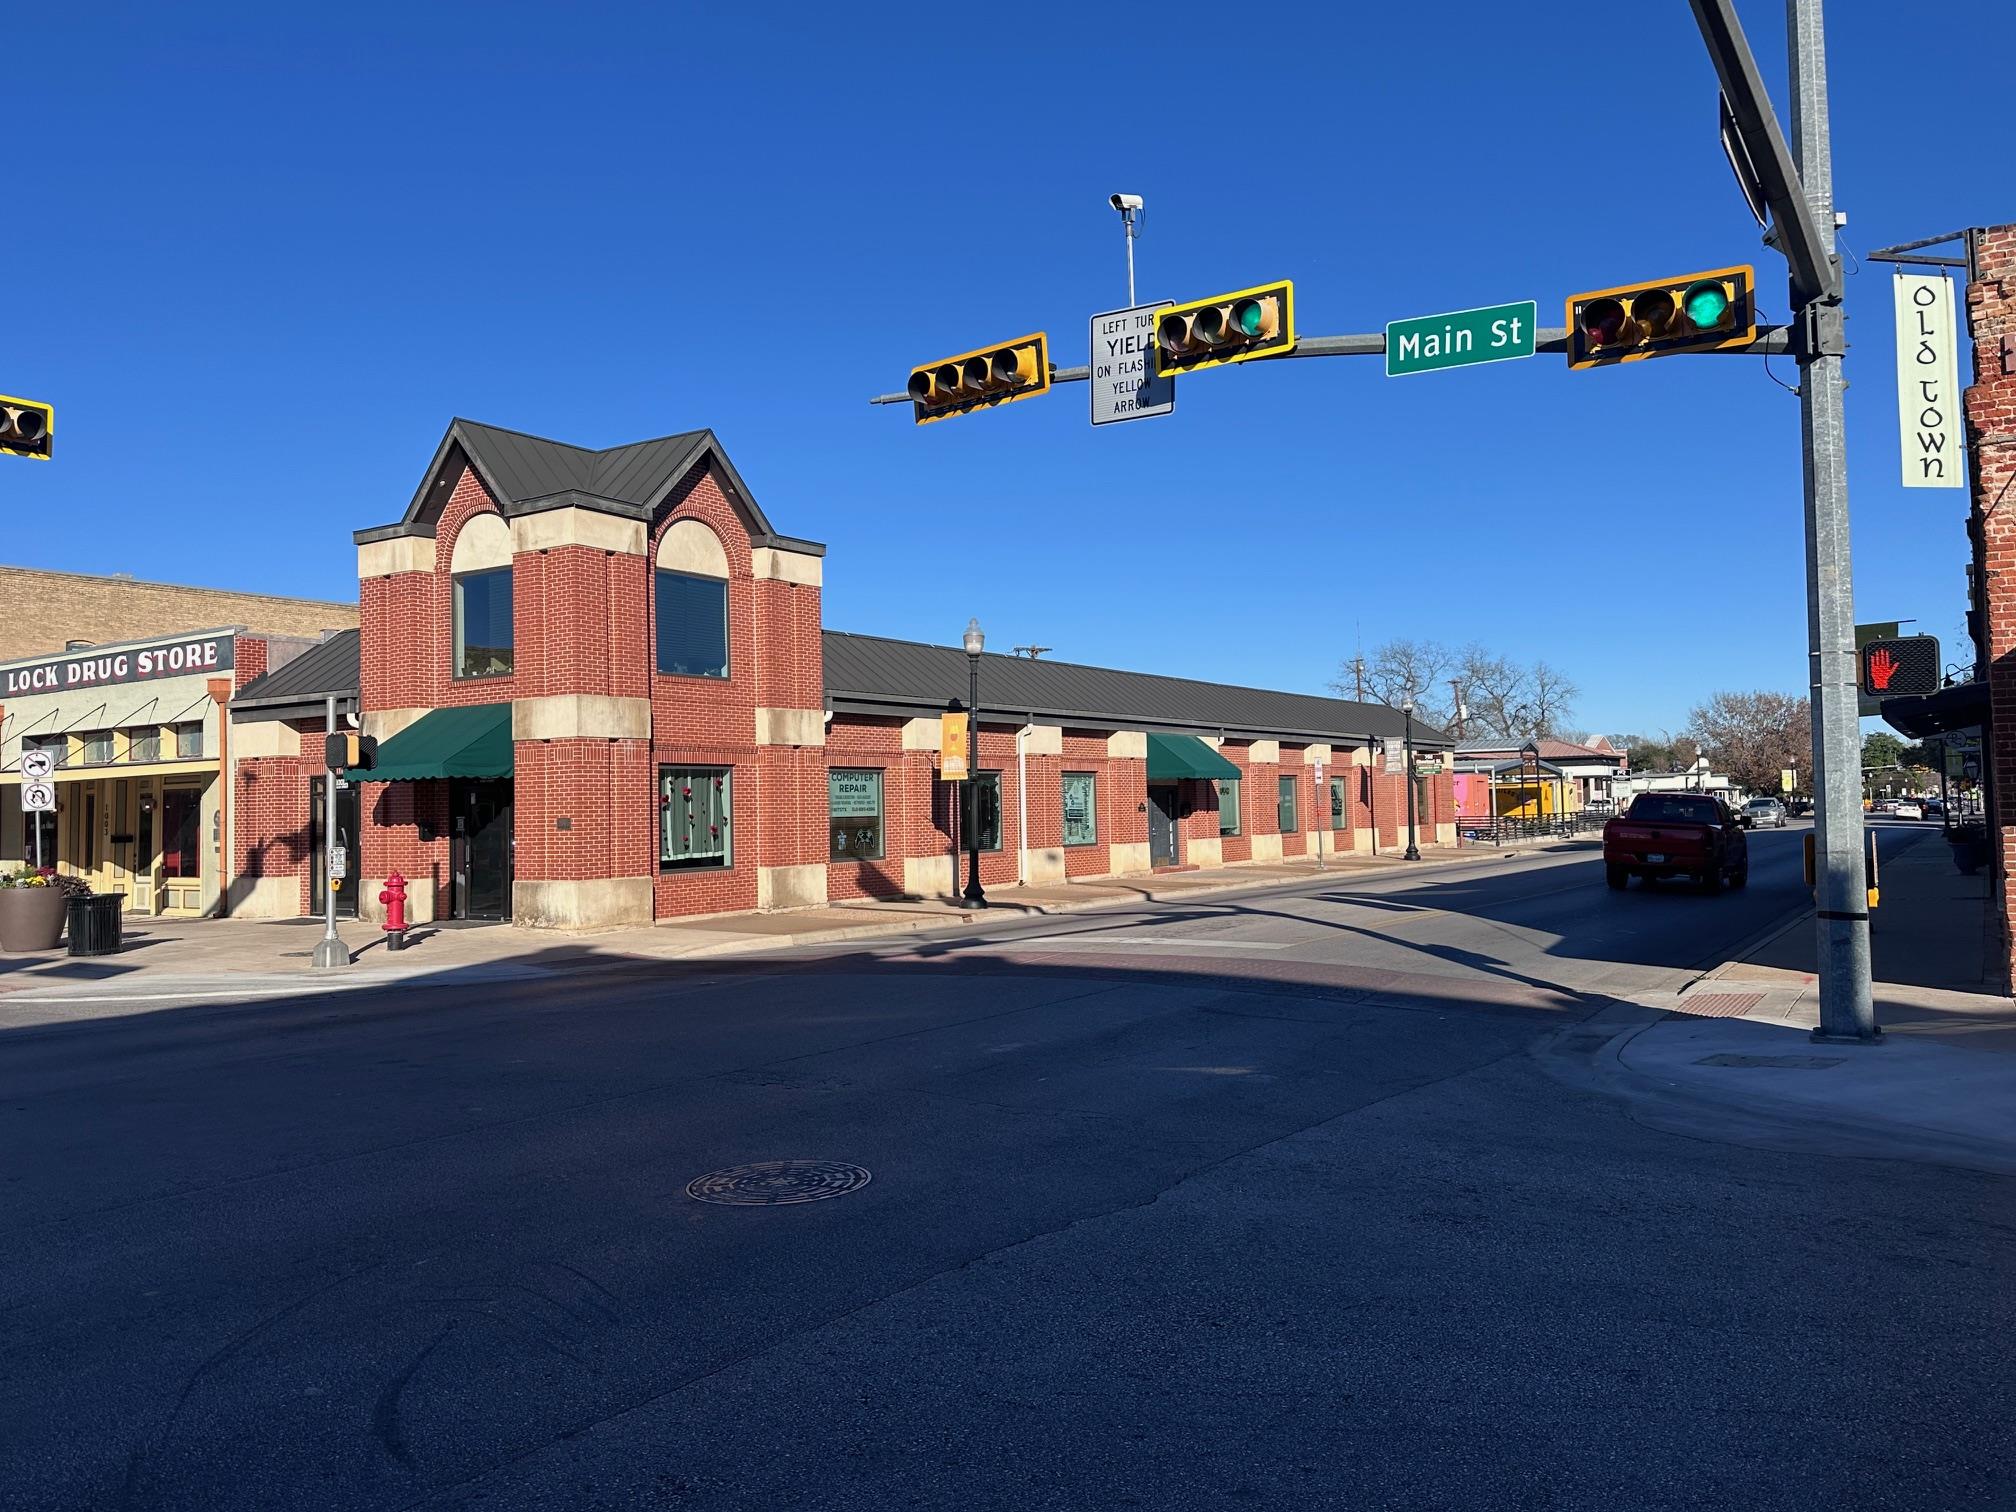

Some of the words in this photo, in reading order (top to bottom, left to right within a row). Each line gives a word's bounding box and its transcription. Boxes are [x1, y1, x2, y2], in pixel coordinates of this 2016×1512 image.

[1102, 318, 1127, 335] LEFT
[1135, 313, 1154, 328] TUR
[1399, 324, 1473, 361] Main
[1490, 316, 1522, 347] St
[1097, 364, 1111, 379] ON
[1118, 357, 1154, 375] FLASHI
[1112, 378, 1152, 395] YELLOW
[1113, 396, 1150, 414] ARROW
[8, 665, 60, 692] LOCK
[67, 655, 128, 684] DRUG
[137, 641, 218, 673] STORE
[831, 772, 874, 782] COMPUTER
[839, 784, 867, 793] REPAIR
